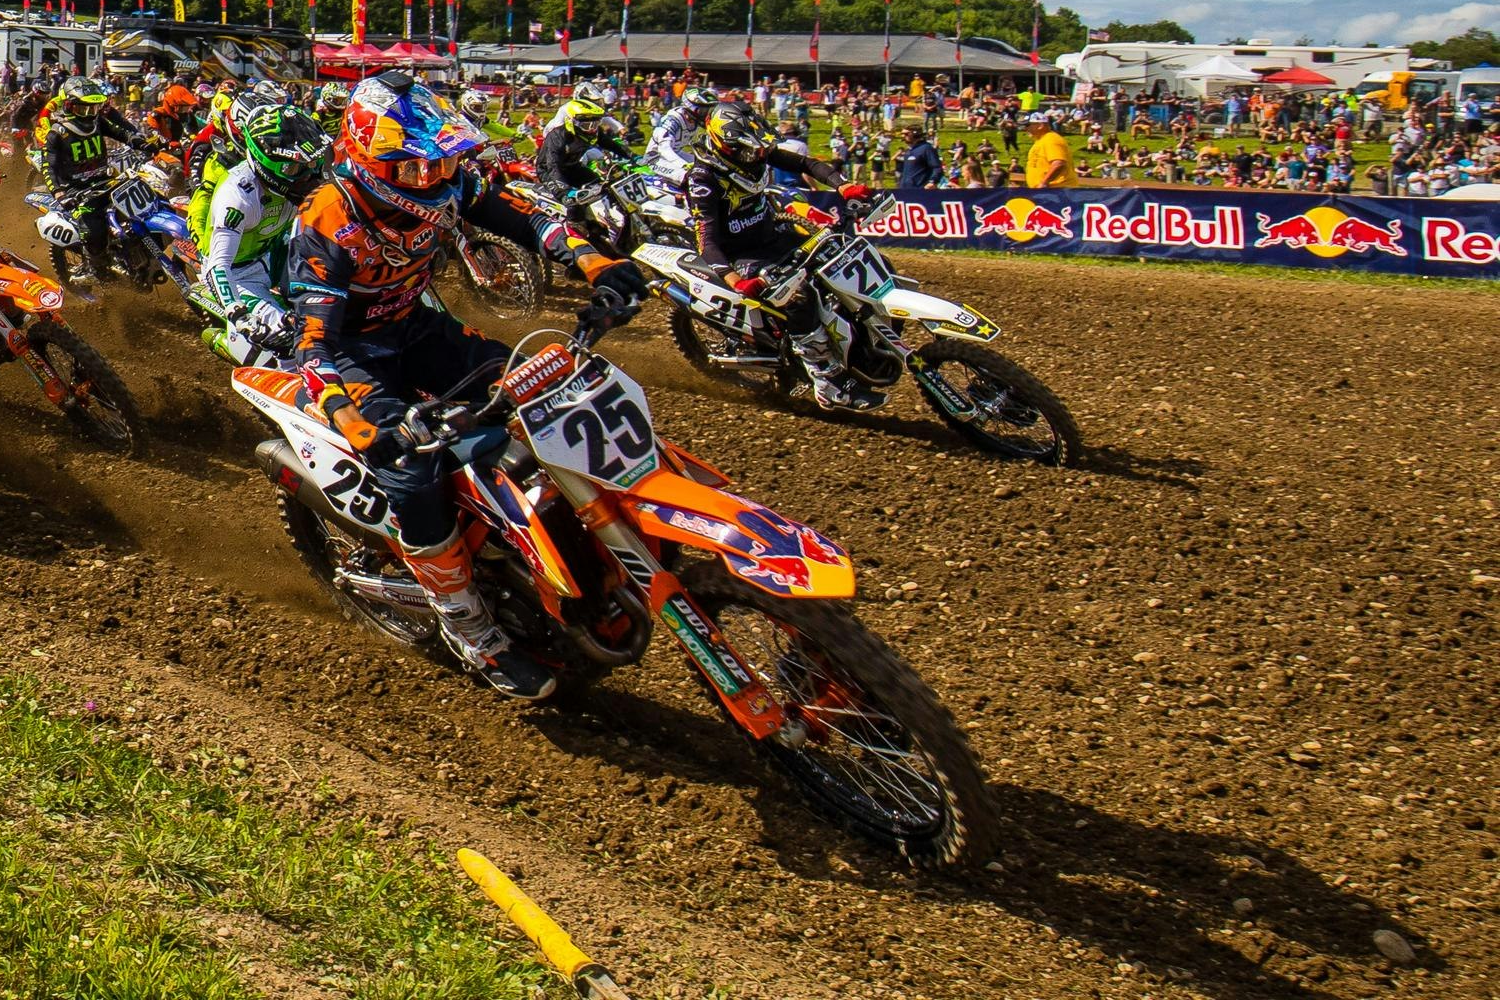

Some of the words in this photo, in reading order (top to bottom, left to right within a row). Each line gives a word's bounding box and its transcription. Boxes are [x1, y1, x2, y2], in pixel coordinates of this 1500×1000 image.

[173, 60, 200, 69] THOR
[71, 135, 102, 162] FLY
[114, 180, 156, 218] 700
[623, 176, 647, 204] 647
[401, 200, 443, 224] Bull
[906, 200, 968, 238] Bull
[1083, 202, 1160, 243] Red
[1160, 204, 1245, 249] Bull
[43, 223, 74, 244] 700
[412, 227, 434, 250] KTM
[1421, 216, 1500, 264] Re
[842, 247, 891, 296] 21
[704, 294, 748, 329] 21
[504, 348, 562, 389] RENTHAL
[513, 357, 569, 398] RENTHAL
[241, 388, 272, 409] DUNLOP
[543, 390, 569, 414] LUCA
[572, 376, 591, 395] OIL
[562, 380, 654, 482] 25
[628, 460, 655, 482] MOTOREX
[322, 458, 389, 526] 25
[668, 510, 696, 531] Red
[676, 627, 736, 692] MOTOREX
